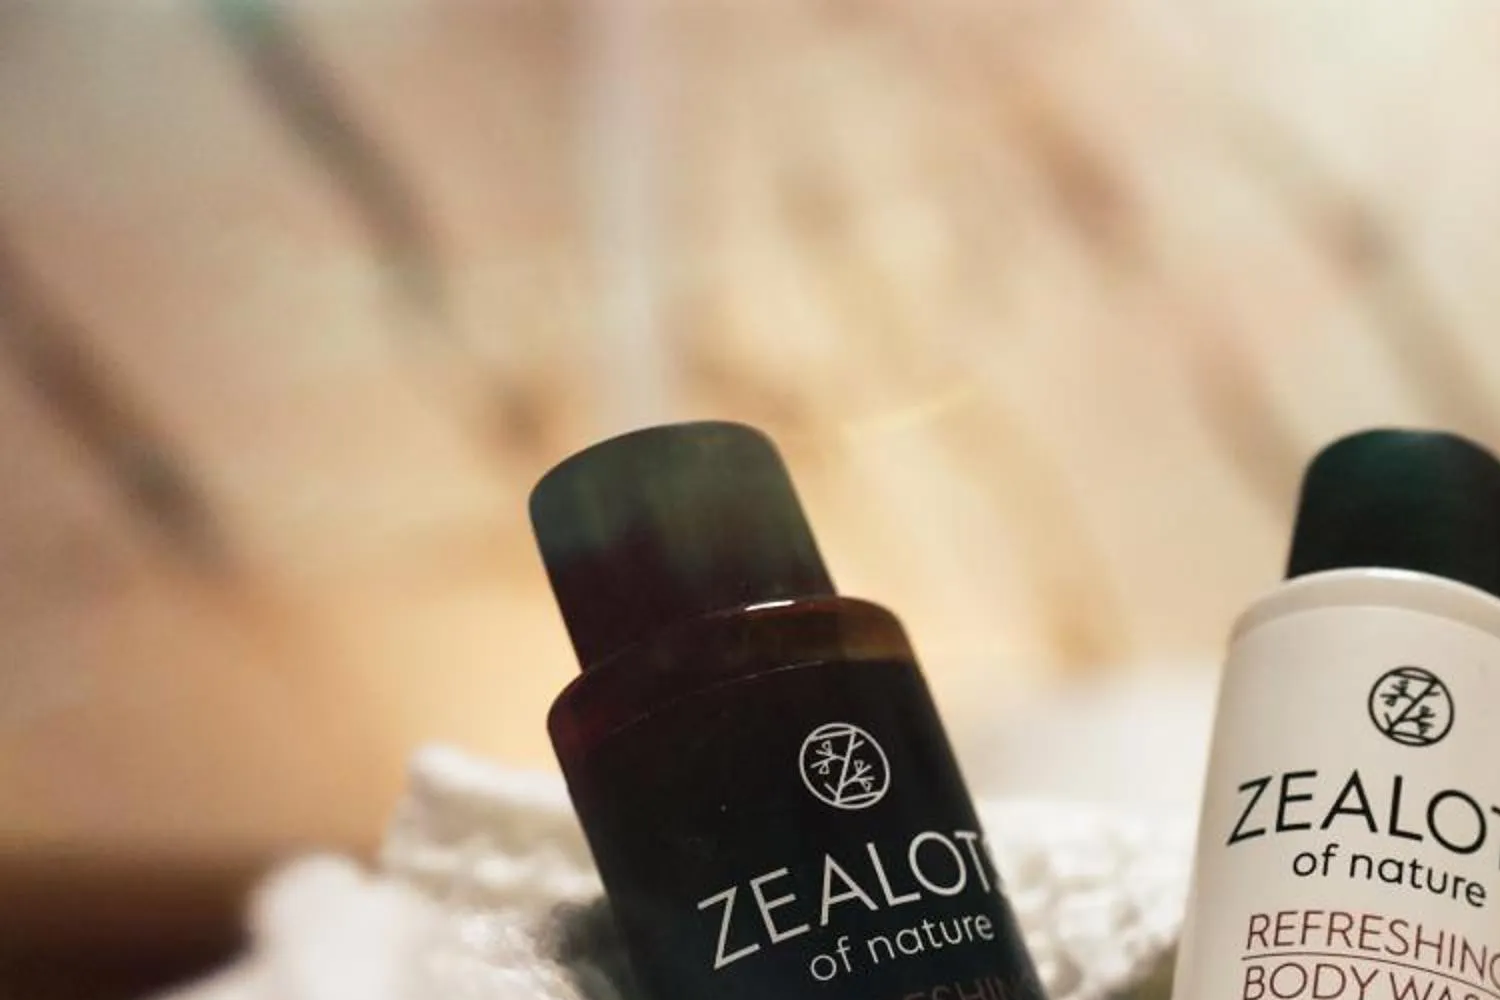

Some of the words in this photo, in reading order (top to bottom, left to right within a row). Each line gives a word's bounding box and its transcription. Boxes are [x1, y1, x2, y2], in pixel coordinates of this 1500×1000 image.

[697, 830, 996, 970] ZEALOT
[1292, 843, 1340, 877] of
[1348, 851, 1487, 907] nature
[810, 936, 853, 982] of
[867, 912, 995, 964] nature
